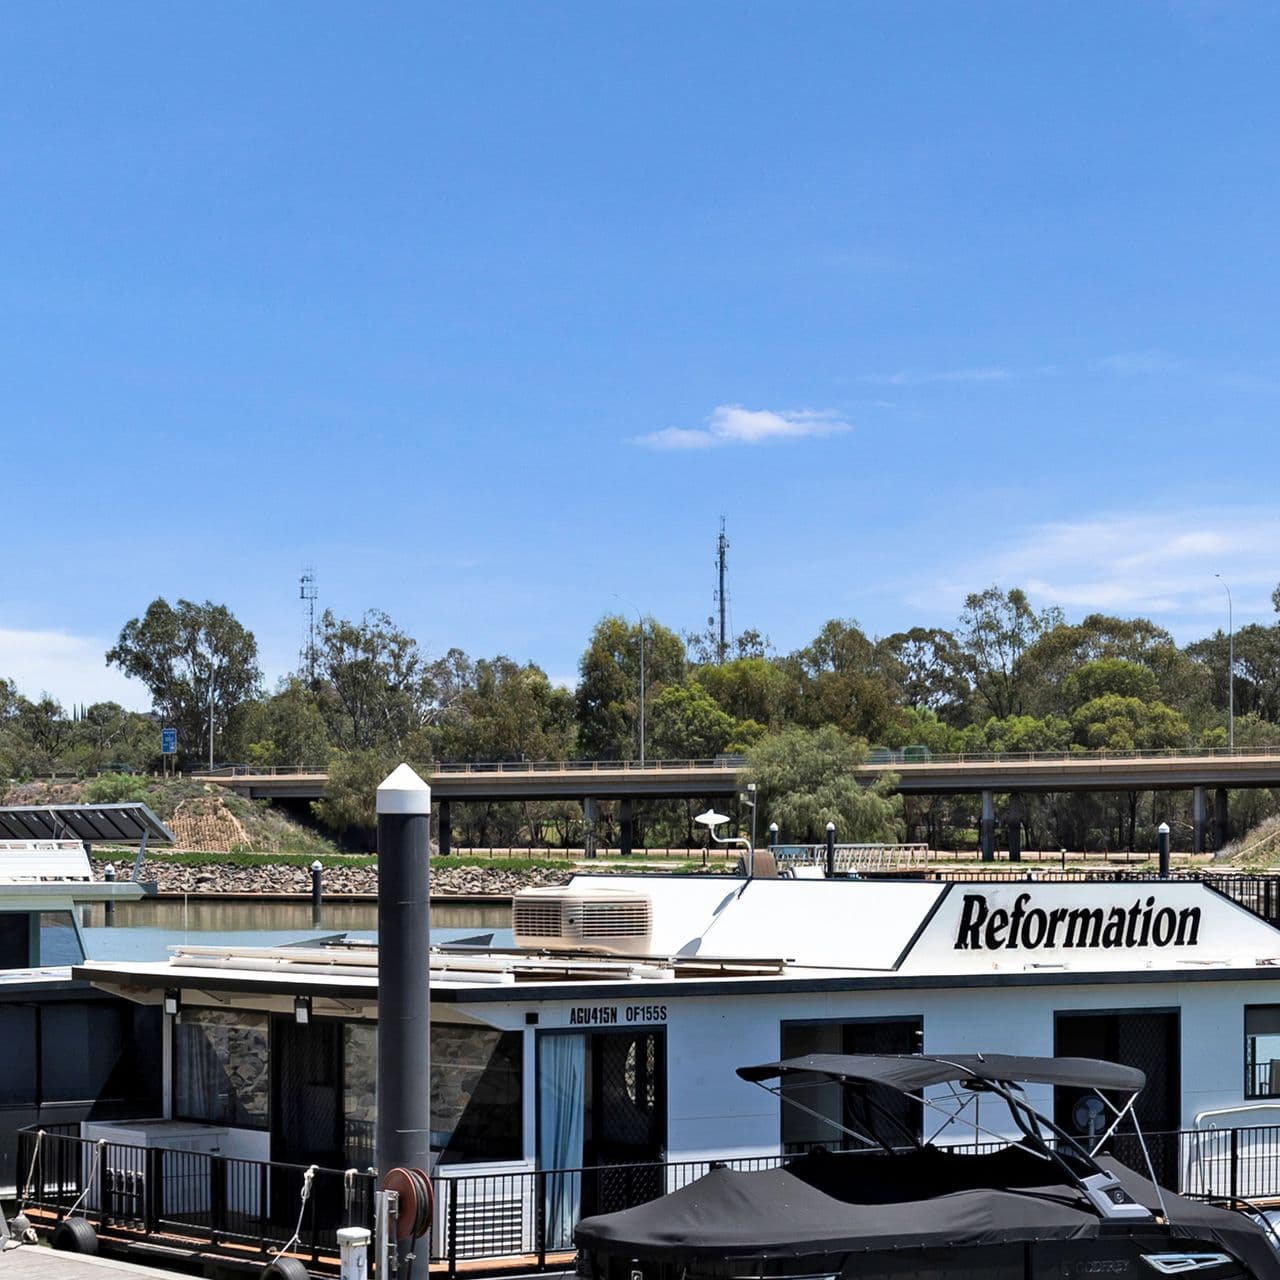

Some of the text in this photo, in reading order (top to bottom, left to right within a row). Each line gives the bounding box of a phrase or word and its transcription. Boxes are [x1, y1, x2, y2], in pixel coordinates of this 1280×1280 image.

[954, 893, 1202, 950] Reformation
[570, 1006, 667, 1025] AGU415N OF155S
